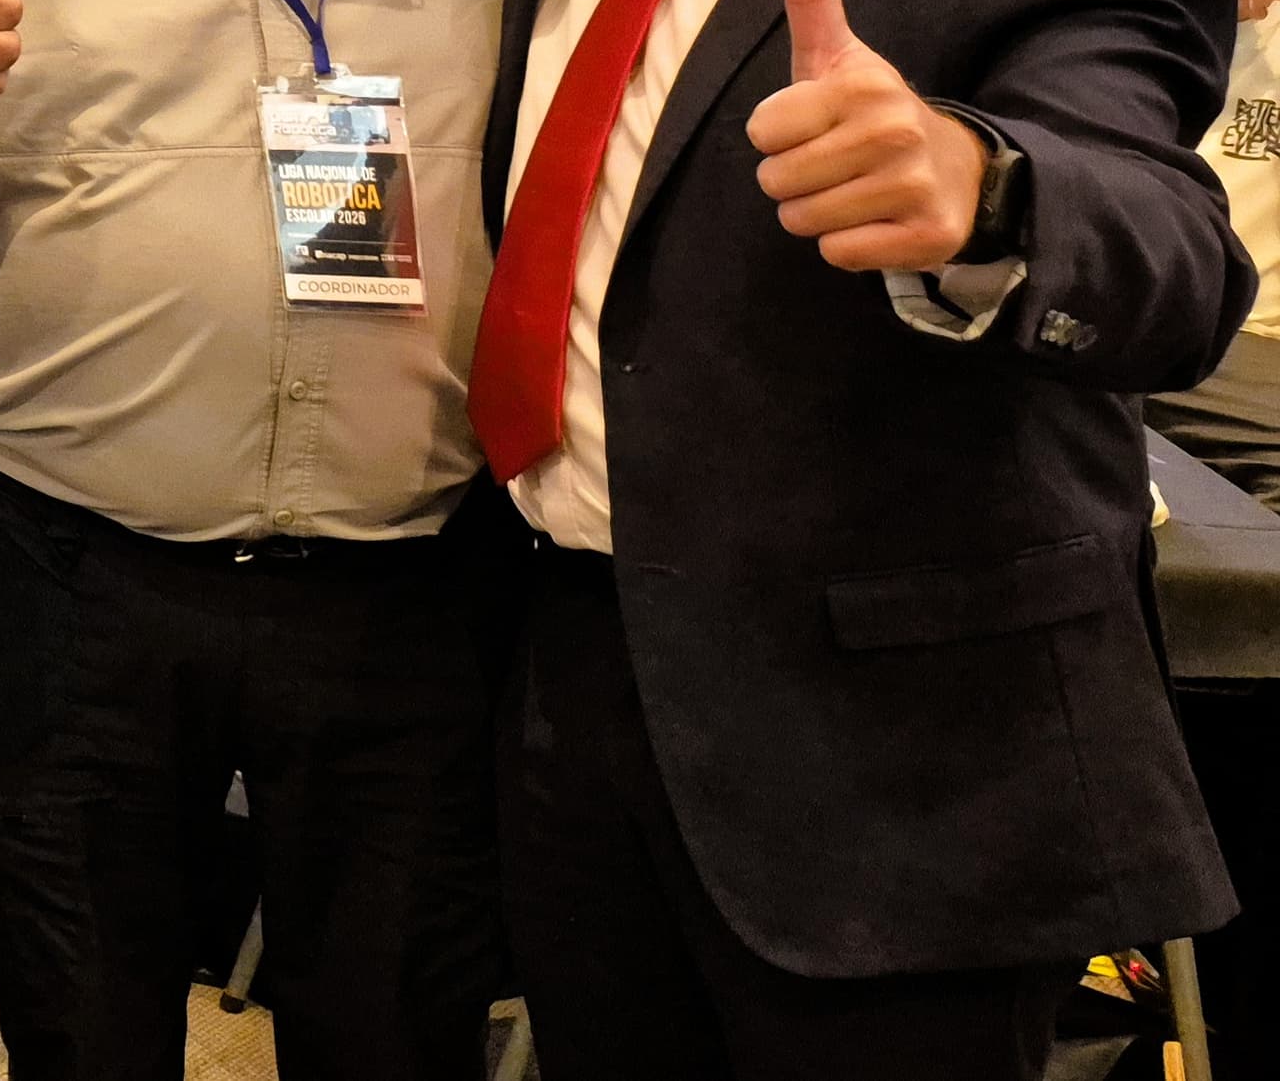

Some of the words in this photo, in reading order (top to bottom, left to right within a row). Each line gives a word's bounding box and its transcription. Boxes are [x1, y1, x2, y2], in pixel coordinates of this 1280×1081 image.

[278, 164, 305, 179] LIGA
[361, 167, 377, 182] DE
[337, 210, 367, 225] 2026
[298, 280, 411, 296] COORDINADOR
